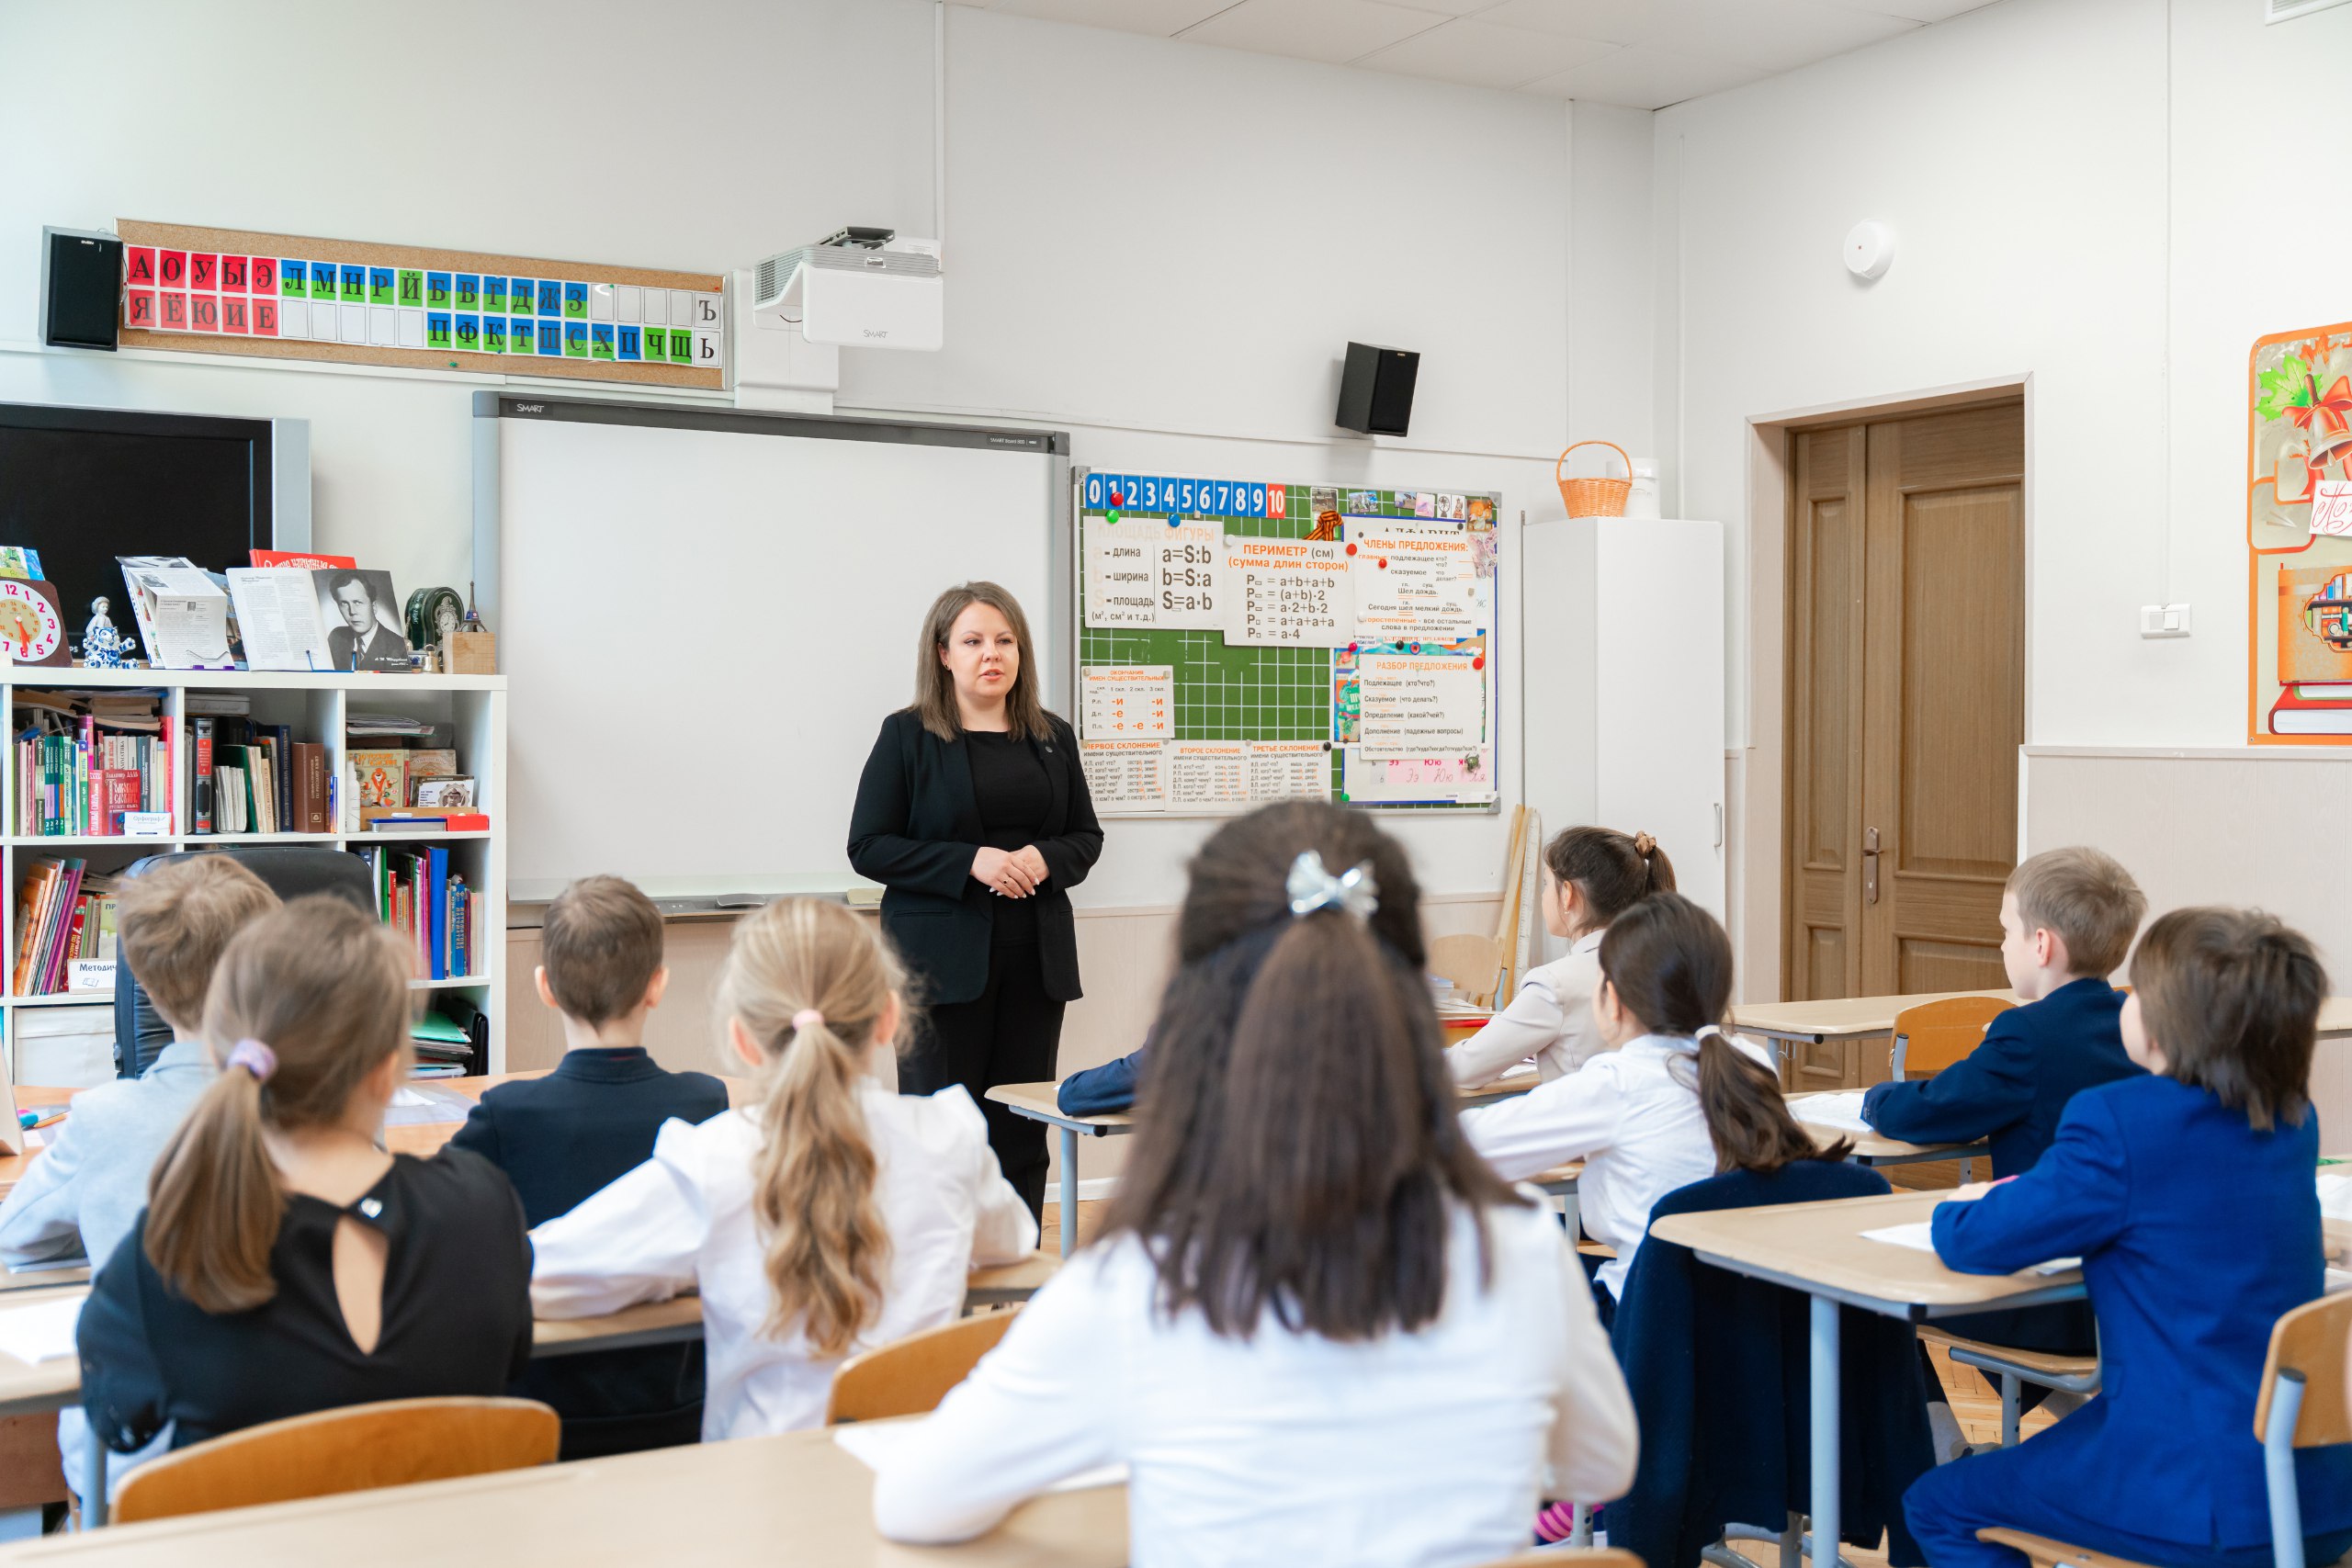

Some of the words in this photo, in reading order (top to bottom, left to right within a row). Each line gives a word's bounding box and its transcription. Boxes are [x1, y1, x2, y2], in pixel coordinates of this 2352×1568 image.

[132, 254, 152, 278] А
[163, 257, 181, 281] О
[195, 260, 213, 284] У
[221, 263, 247, 286] Ы
[256, 265, 273, 288] Э
[285, 267, 304, 290] Л
[314, 269, 336, 293] М
[345, 273, 364, 296] Н
[372, 276, 389, 297] Р
[401, 273, 420, 300] Й
[431, 278, 446, 302] Б
[459, 281, 476, 303] В
[488, 283, 503, 306] Г
[513, 286, 530, 313] Д
[538, 288, 560, 310] Ж
[569, 288, 582, 312] З
[698, 299, 717, 321] Ъ
[132, 297, 152, 319] Я
[165, 294, 183, 322] Ё
[191, 301, 218, 325] Ю
[226, 304, 244, 327] И
[258, 306, 275, 329] Е
[430, 319, 448, 343] П
[457, 321, 478, 344] Ф
[487, 322, 503, 345] К
[514, 325, 530, 347] Т
[538, 327, 560, 348] Ш
[570, 328, 583, 351] С
[594, 330, 613, 353] Х
[621, 333, 639, 357] Ц
[649, 333, 663, 355] Ч
[671, 336, 692, 360] Щ
[700, 338, 714, 359] Ь
[864, 330, 888, 339] SMART
[517, 404, 544, 412] SMART
[1089, 479, 1101, 503] 0
[1127, 482, 1137, 505] 2
[1146, 483, 1156, 506] 3
[1164, 484, 1175, 507] 4
[1182, 485, 1193, 508] 5
[1200, 486, 1210, 509] 6
[1218, 487, 1228, 510] 7
[1235, 488, 1246, 511] 8
[1253, 489, 1263, 512] 9
[1269, 490, 1284, 513] 10
[1164, 526, 1215, 543] ФИГУРЫ
[1364, 539, 1396, 549] ЧЛЕНЫ
[1398, 540, 1469, 552] ПРЕДЛОЖЕНИЯ:
[1113, 547, 1141, 558] длина
[1162, 545, 1212, 563] a=S:b
[1243, 545, 1307, 557] ПЕРИМЕТР
[1311, 547, 1334, 559] (см)
[1228, 557, 1270, 569] (сумма
[1273, 560, 1302, 570] длин
[1306, 561, 1349, 572] сторон)
[1114, 571, 1148, 583] ширина
[1162, 568, 1212, 587] b=S:a
[1280, 576, 1335, 588] a+b+a+b
[6, 584, 17, 595] 12
[25, 591, 29, 601] 1
[1114, 597, 1154, 607] площадь
[38, 603, 45, 613] 2
[48, 618, 55, 629] 3
[1281, 616, 1335, 627] a+a+a+a
[46, 634, 53, 644] 4
[3, 641, 9, 651] 7
[36, 644, 44, 655] 5
[1376, 661, 1408, 671] РАЗБОР
[1408, 662, 1468, 671] ПРЕДЛОЖЕНИЯ
[1364, 679, 1403, 687] Подлежащее
[1364, 695, 1396, 704] Сказуемое
